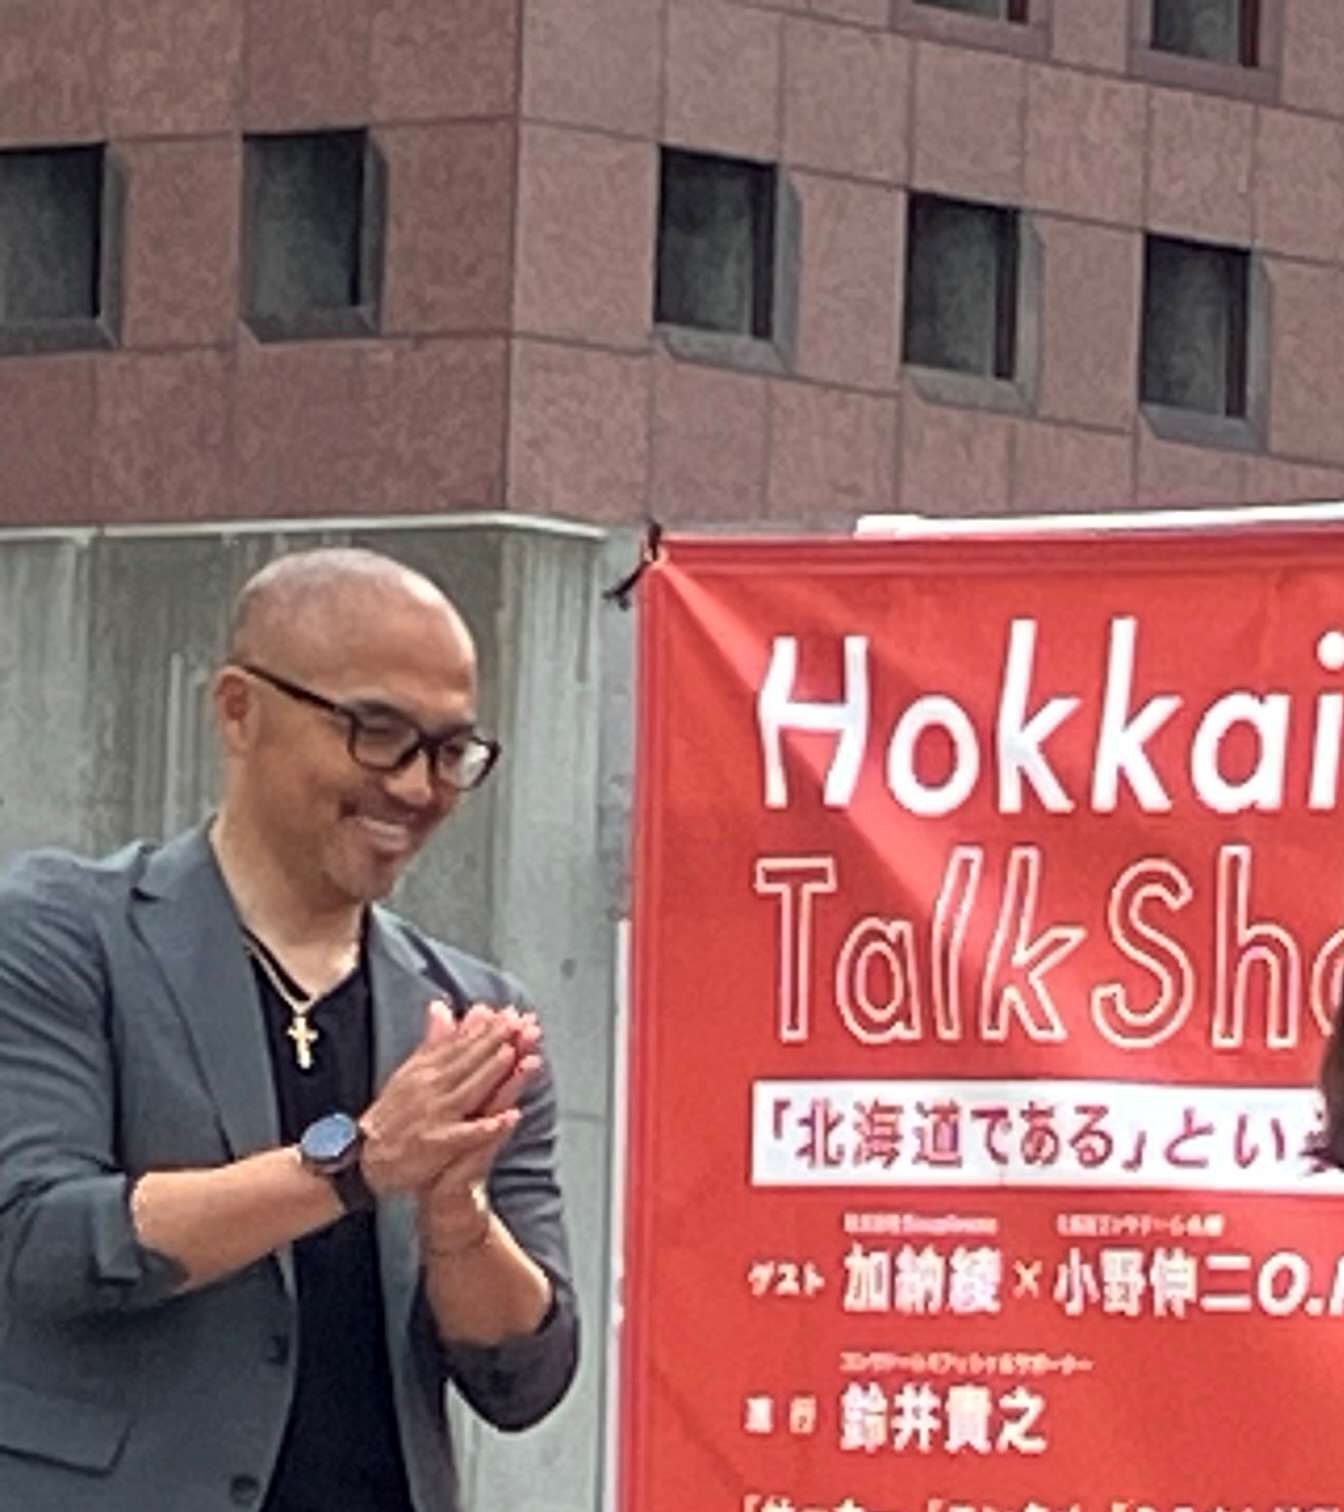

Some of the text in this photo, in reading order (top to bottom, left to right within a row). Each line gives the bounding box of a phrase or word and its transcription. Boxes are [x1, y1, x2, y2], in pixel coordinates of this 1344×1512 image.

[772, 1098, 1326, 1174] 「北海道である」とい
